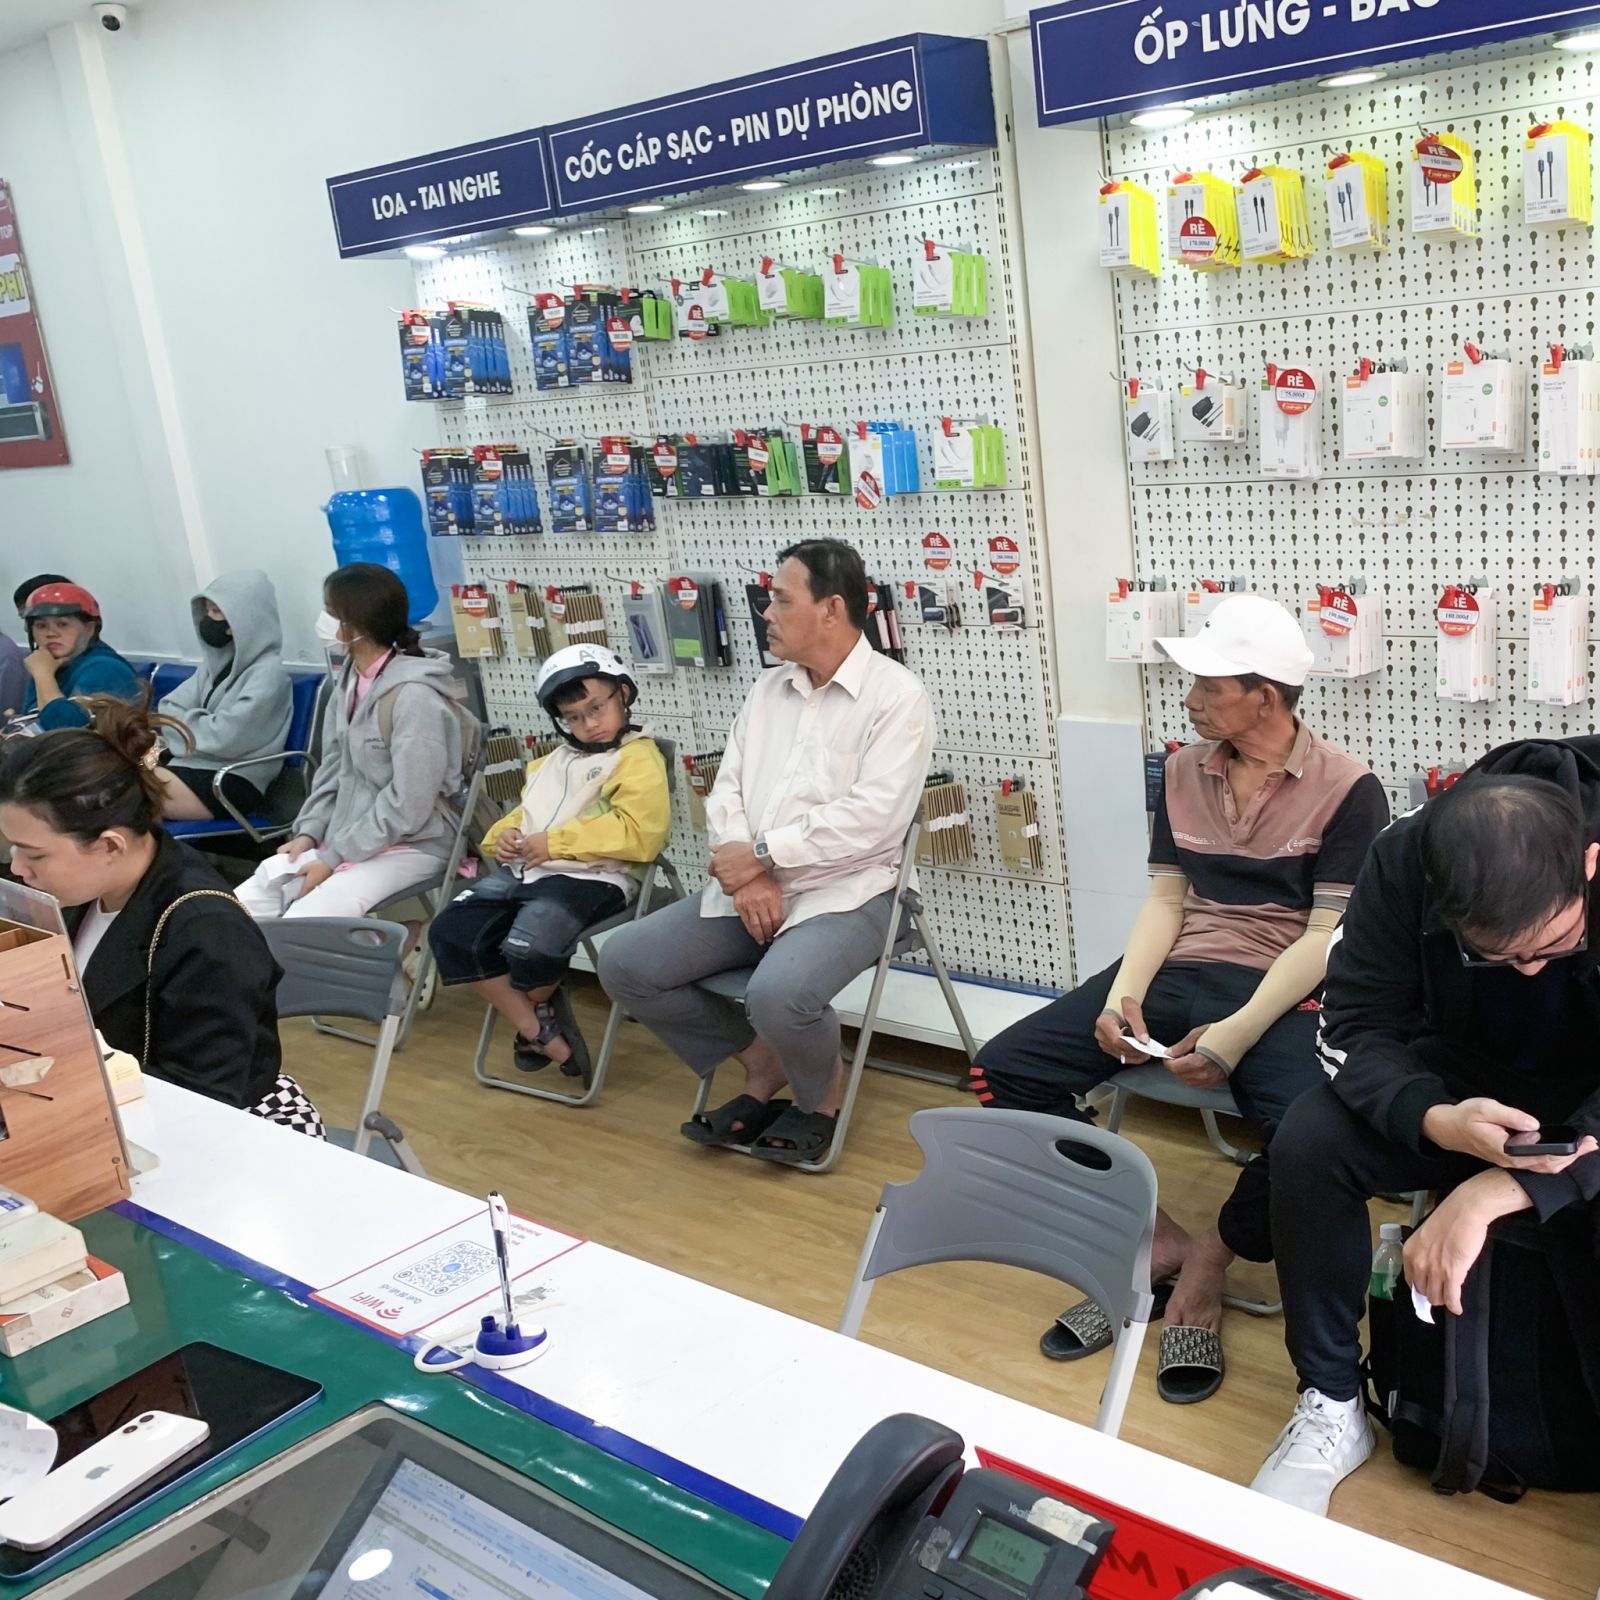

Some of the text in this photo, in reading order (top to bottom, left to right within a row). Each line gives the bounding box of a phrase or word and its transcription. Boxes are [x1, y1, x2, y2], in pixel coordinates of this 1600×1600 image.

[1134, 6, 1189, 65] ỐP
[1201, 0, 1310, 52] LƯNG
[565, 139, 613, 182] CỐC
[617, 132, 662, 170] CÁP
[666, 125, 713, 165] SẠC
[730, 111, 771, 146] PIN
[775, 97, 810, 141] DỰ
[816, 80, 913, 128] PHÒNG
[372, 192, 408, 220] LOA
[418, 183, 446, 211] TAI
[448, 171, 501, 205] NGHE
